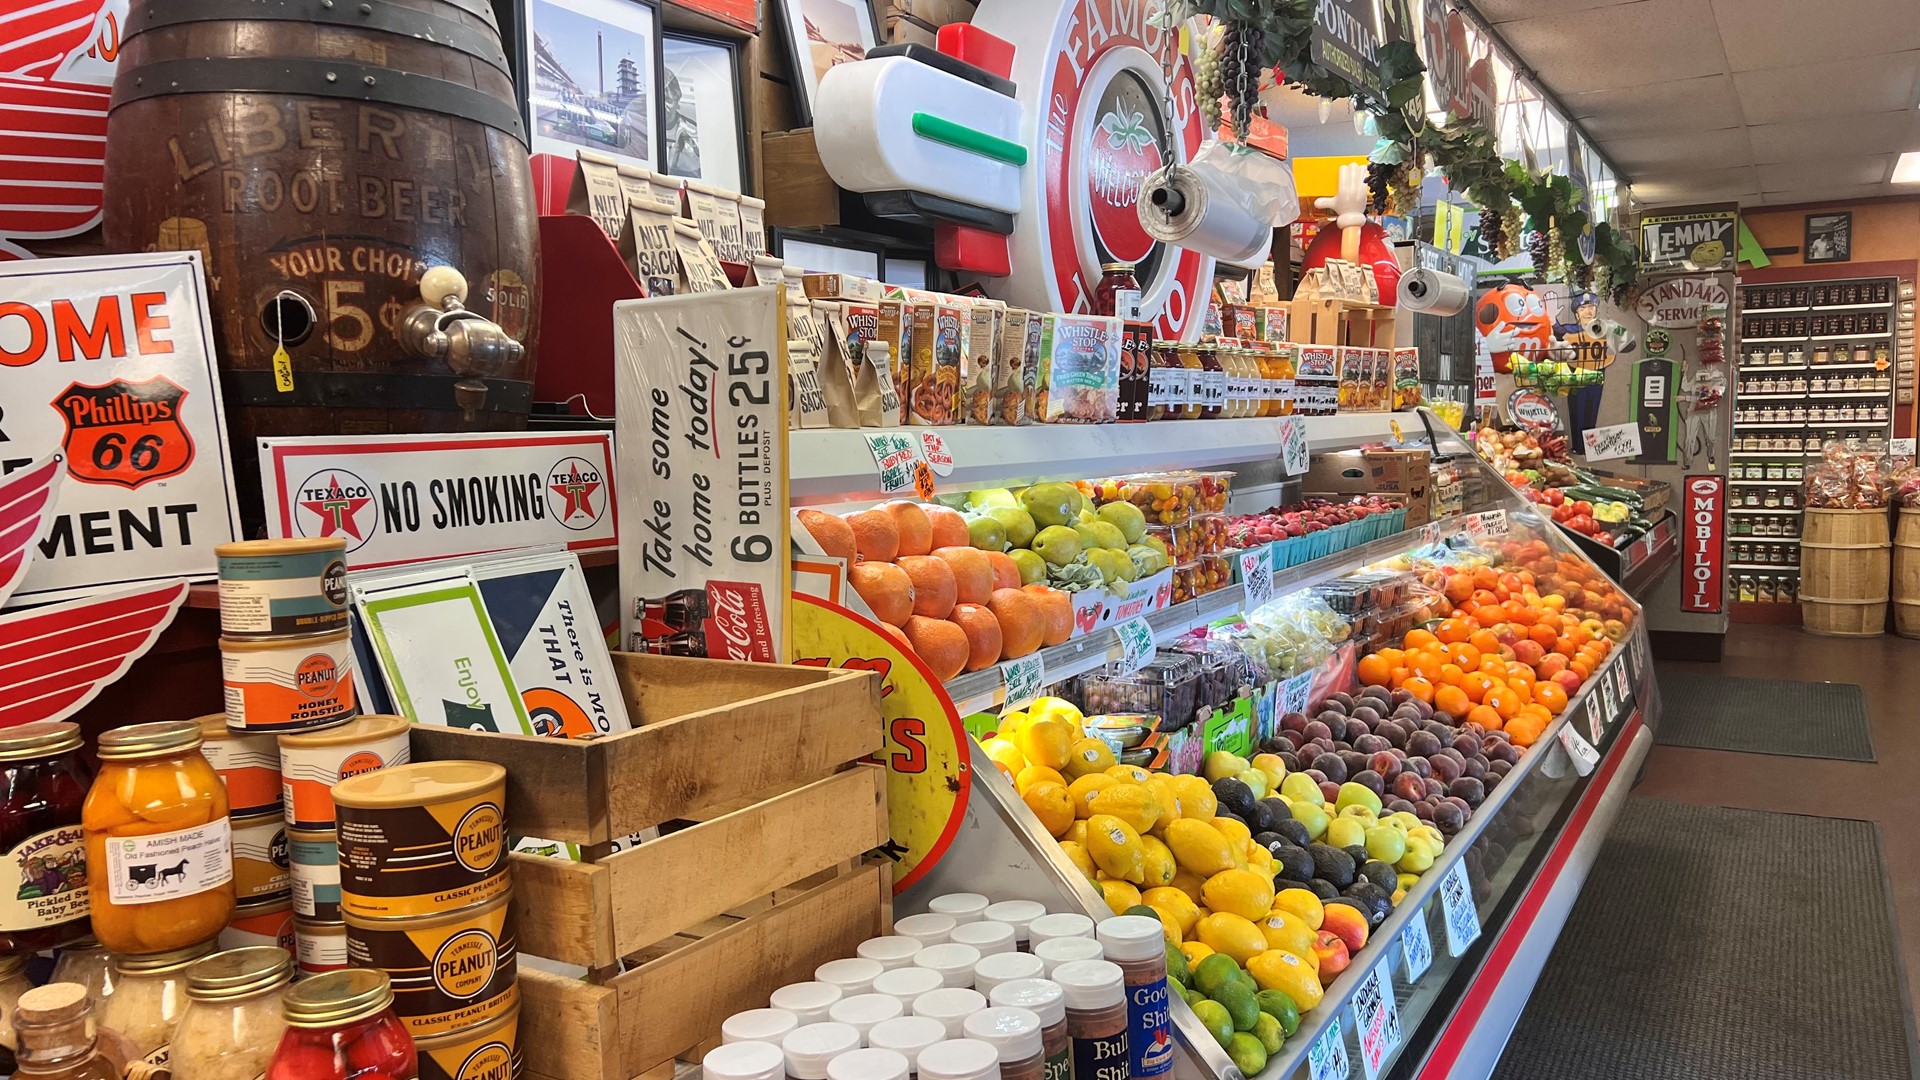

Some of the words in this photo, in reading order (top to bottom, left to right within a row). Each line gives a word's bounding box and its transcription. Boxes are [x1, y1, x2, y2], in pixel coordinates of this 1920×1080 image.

[1313, 0, 1380, 67] PONTIAC
[1046, 93, 1069, 155] The
[221, 169, 347, 215] ROOT
[358, 175, 467, 228] BEER
[594, 195, 618, 216] NUT
[639, 224, 669, 250] NUT
[721, 225, 739, 243] NUT
[746, 232, 762, 249] NUT
[1643, 221, 1733, 261] LEMMY
[270, 246, 344, 280] YOUR
[351, 247, 428, 280] CHOI
[638, 250, 679, 276] SACK
[720, 244, 743, 263] SACK
[689, 262, 711, 281] NUT
[486, 288, 528, 310] SOLID
[1639, 279, 1726, 312] STANDARD
[847, 313, 878, 329] WHIST
[938, 315, 961, 332] WHISTLE
[1656, 307, 1701, 322] SERVIC
[0, 291, 174, 367] OME
[794, 315, 815, 338] NUT
[944, 328, 957, 339] STOP
[1058, 325, 1109, 342] WHISTLE
[1072, 337, 1097, 348] STOP
[1301, 351, 1335, 361] WHISTLE
[727, 335, 770, 407] 25¢
[797, 370, 818, 392] NUT
[1056, 373, 1071, 382] FRIED
[1070, 372, 1086, 380] GREEN
[1086, 373, 1102, 383] TOMATO
[676, 326, 719, 451] today!
[64, 393, 173, 425] Phillips
[800, 390, 827, 413] SACK
[882, 390, 900, 413] SACK
[1518, 408, 1549, 419] WHISTLE
[651, 387, 671, 480] some
[91, 432, 164, 472] 66
[762, 430, 771, 474] DEPOSIT
[552, 472, 598, 485] TEXACO
[737, 414, 760, 525] BOTTLES
[882, 465, 902, 483] GRAPE
[304, 486, 367, 501] TEXACO
[885, 474, 905, 491] FRUIT
[1383, 483, 1399, 491] USA
[380, 481, 421, 534] NO
[430, 473, 545, 529] SMOKING
[763, 482, 772, 507] PLUS
[682, 473, 713, 567] home
[33, 504, 198, 562] MENT
[643, 499, 676, 579] Take
[730, 534, 773, 563] 6
[1693, 497, 1714, 608] MOBILOIL
[751, 586, 766, 637] Refreshing
[539, 625, 572, 684] THAT
[756, 640, 769, 659] and
[298, 667, 335, 685] PEANUT
[557, 600, 585, 662] There
[580, 667, 592, 686] is
[588, 692, 611, 734] MO
[454, 656, 486, 711] Enjoy
[290, 704, 344, 720] ROASTED
[298, 697, 339, 710] HONEY
[469, 815, 494, 829] TENNESSEE
[17, 835, 54, 863] JAKE
[147, 838, 178, 848] AMISH
[180, 830, 204, 843] MADE
[460, 823, 501, 853] PEANUT
[125, 852, 138, 860] Old
[139, 848, 179, 859] Fashioned
[473, 849, 494, 862] COMPANY
[253, 881, 291, 893] BUTTE
[434, 888, 471, 903] CLASSIC
[473, 879, 498, 894] PEANUT
[27, 893, 71, 909] Pickled
[37, 905, 66, 917] Baby
[70, 899, 89, 910] Bee
[450, 941, 483, 956] TENNESSEE
[440, 949, 492, 979] PEANUT
[456, 976, 482, 988] COMPANY
[1134, 986, 1167, 1006] Goo
[413, 1014, 452, 1026] CLASSIC
[454, 1004, 487, 1019] PEANUT
[488, 990, 512, 1008] BRITTLE
[1093, 1031, 1128, 1060] Bull
[472, 1054, 501, 1071] TENNESSEE
